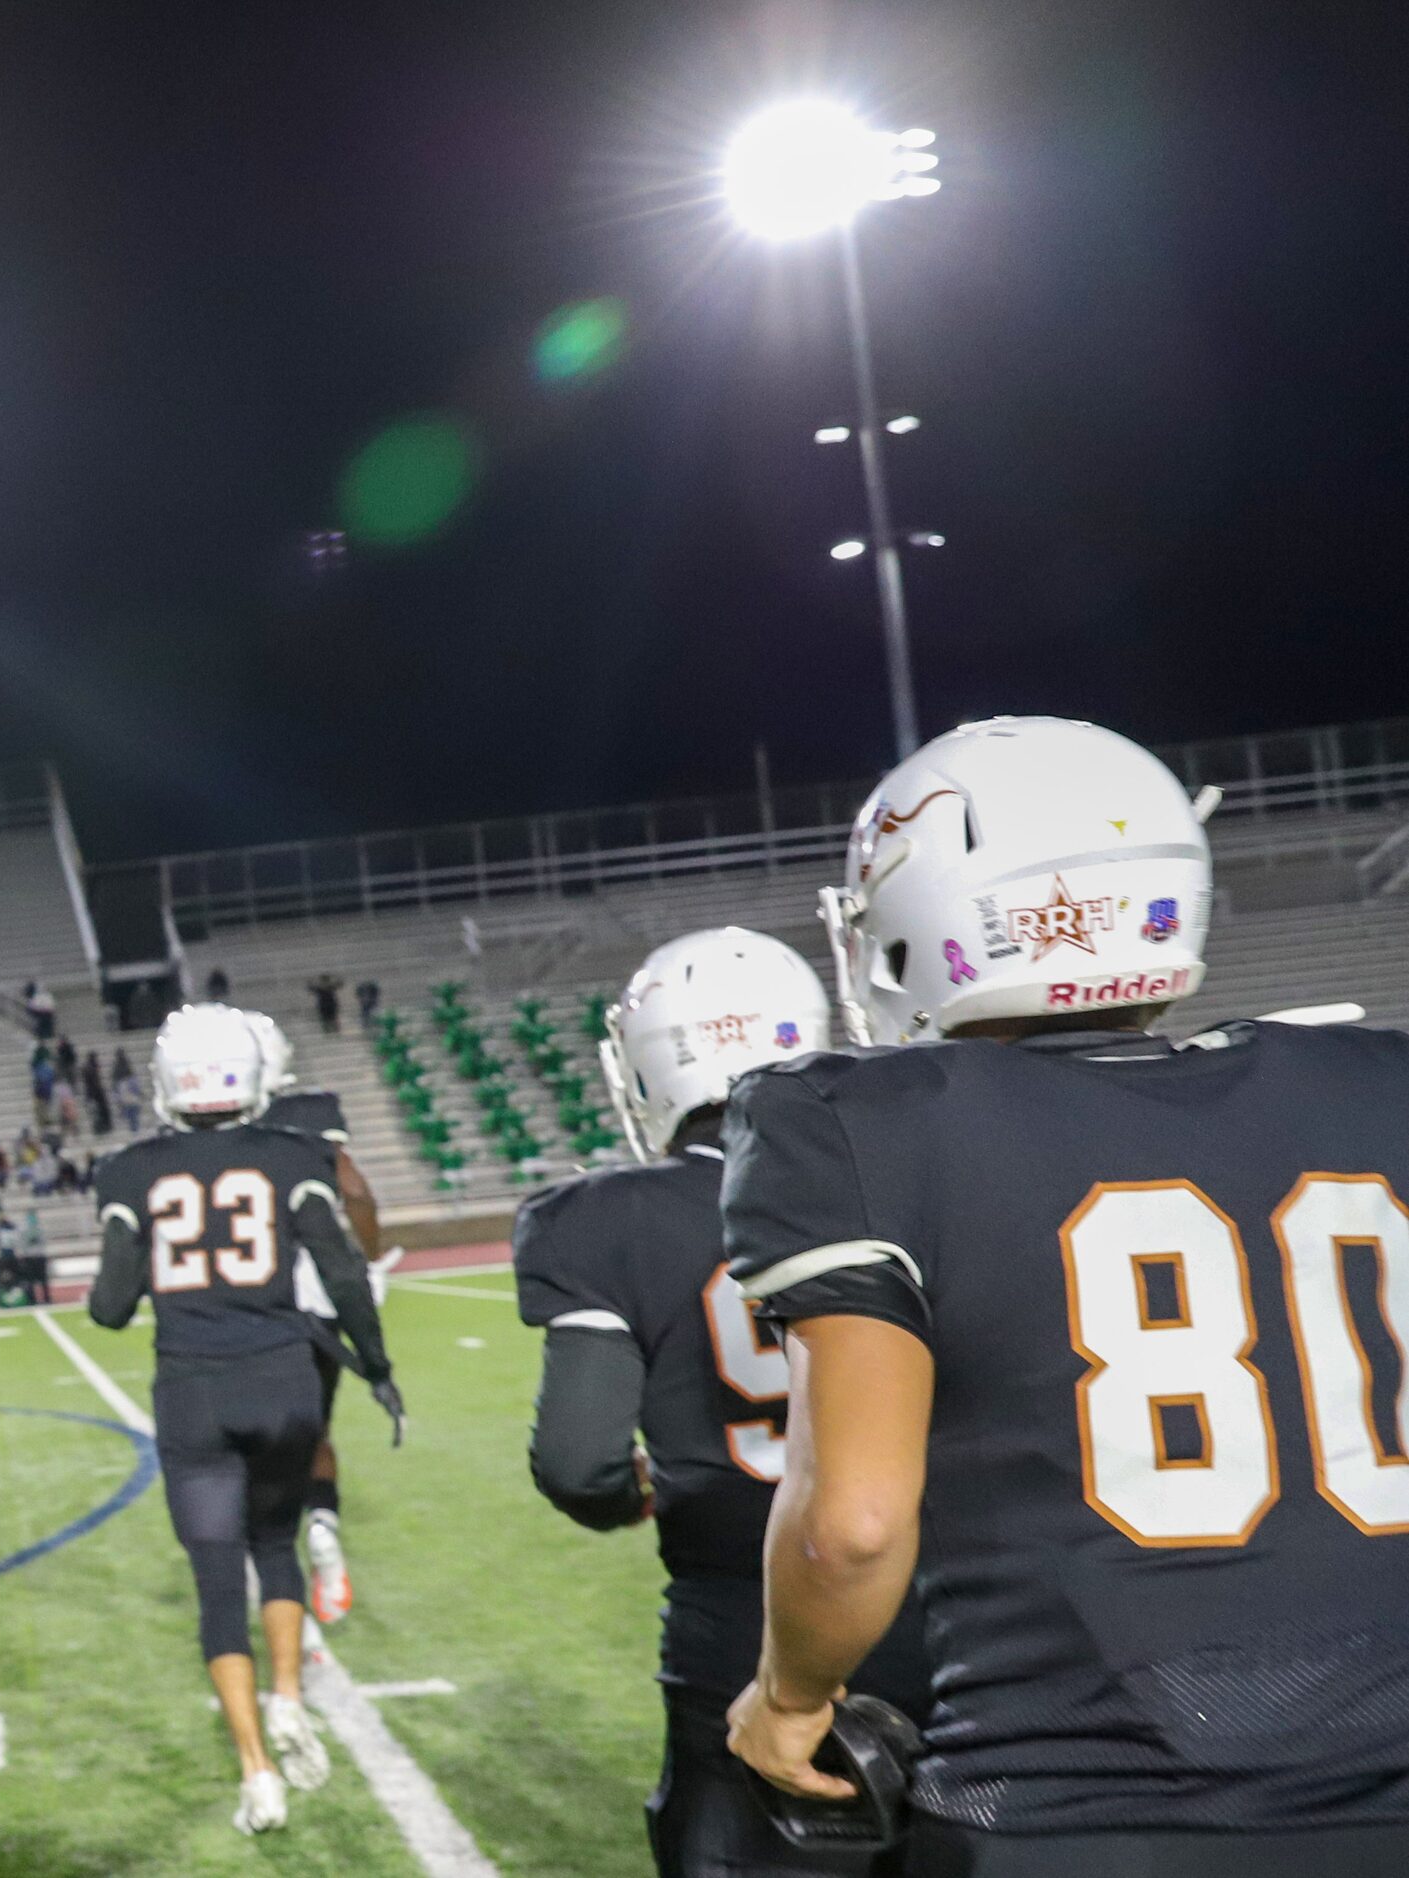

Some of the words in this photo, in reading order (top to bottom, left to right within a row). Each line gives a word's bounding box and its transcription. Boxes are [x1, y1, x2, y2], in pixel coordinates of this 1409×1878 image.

[1007, 897, 1114, 943] RRH
[1047, 968, 1190, 1006] Riddell
[147, 1167, 278, 1293] 23
[1058, 1171, 1409, 1547] 80
